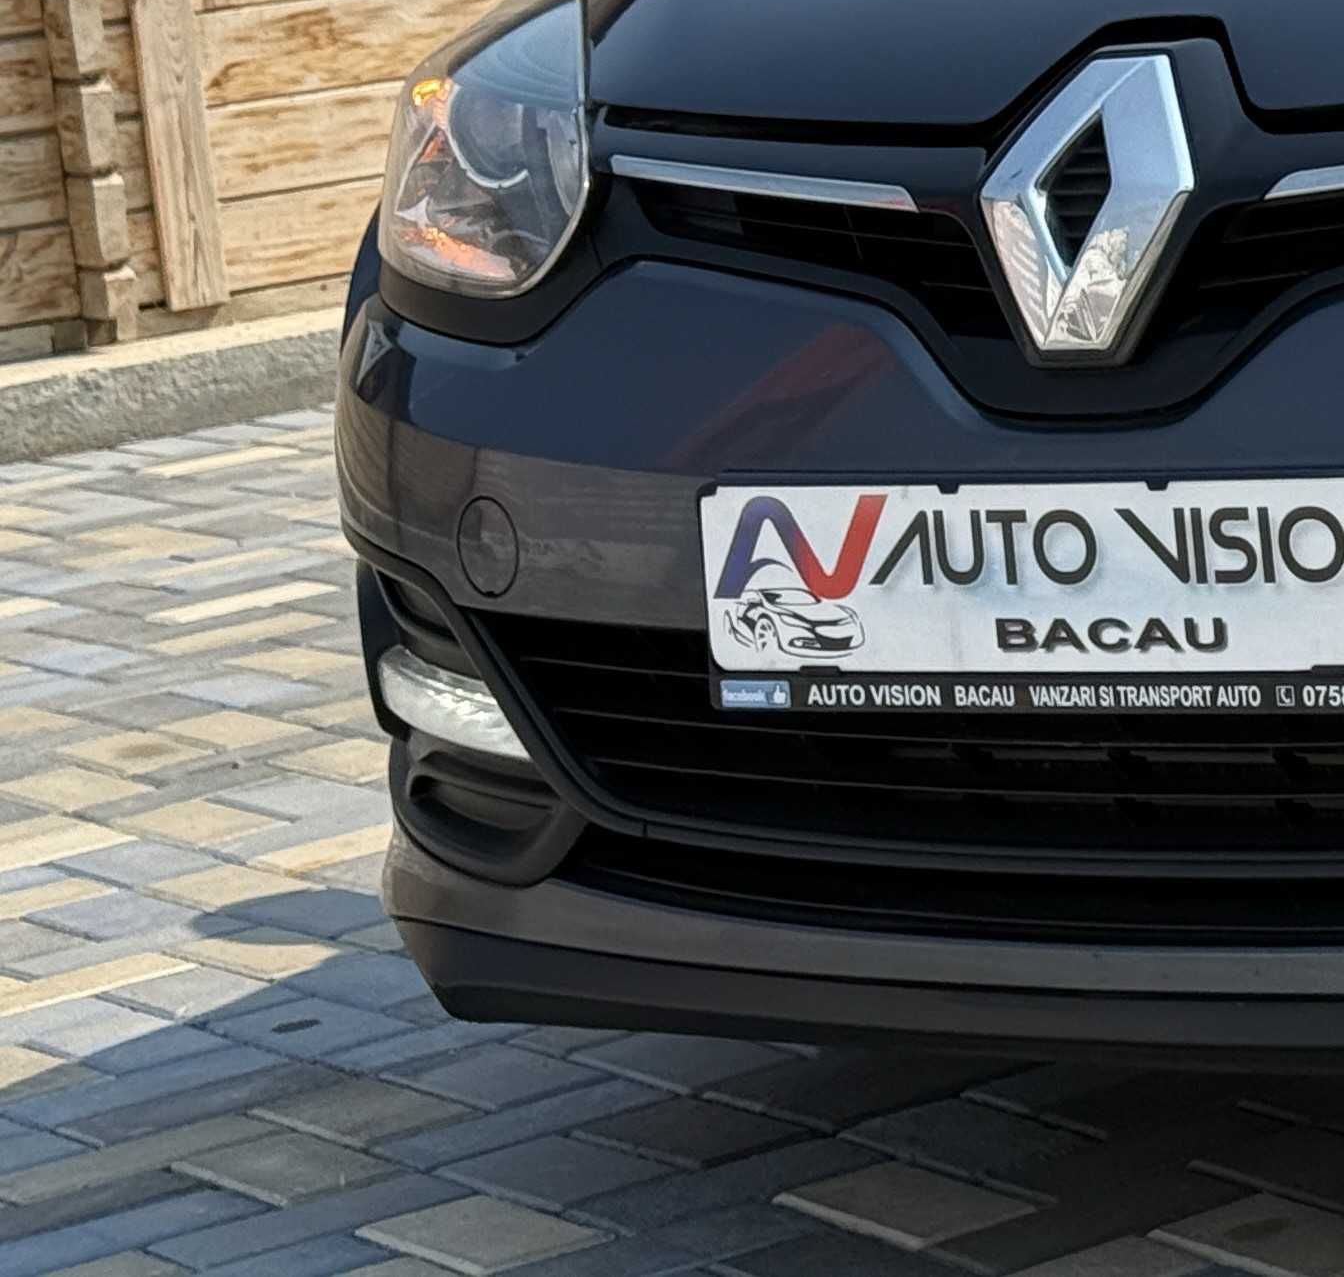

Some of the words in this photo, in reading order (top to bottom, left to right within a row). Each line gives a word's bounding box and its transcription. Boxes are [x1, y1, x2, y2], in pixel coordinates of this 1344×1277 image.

[870, 507, 1097, 585] AUTO
[994, 618, 1229, 655] BACAU
[807, 685, 866, 705] AUTO
[869, 685, 942, 705] VISION
[954, 685, 1015, 706] BACAU
[1028, 685, 1096, 707] VANZARI
[1117, 685, 1214, 707] TRANSPORT
[1216, 685, 1261, 707] AUTO
